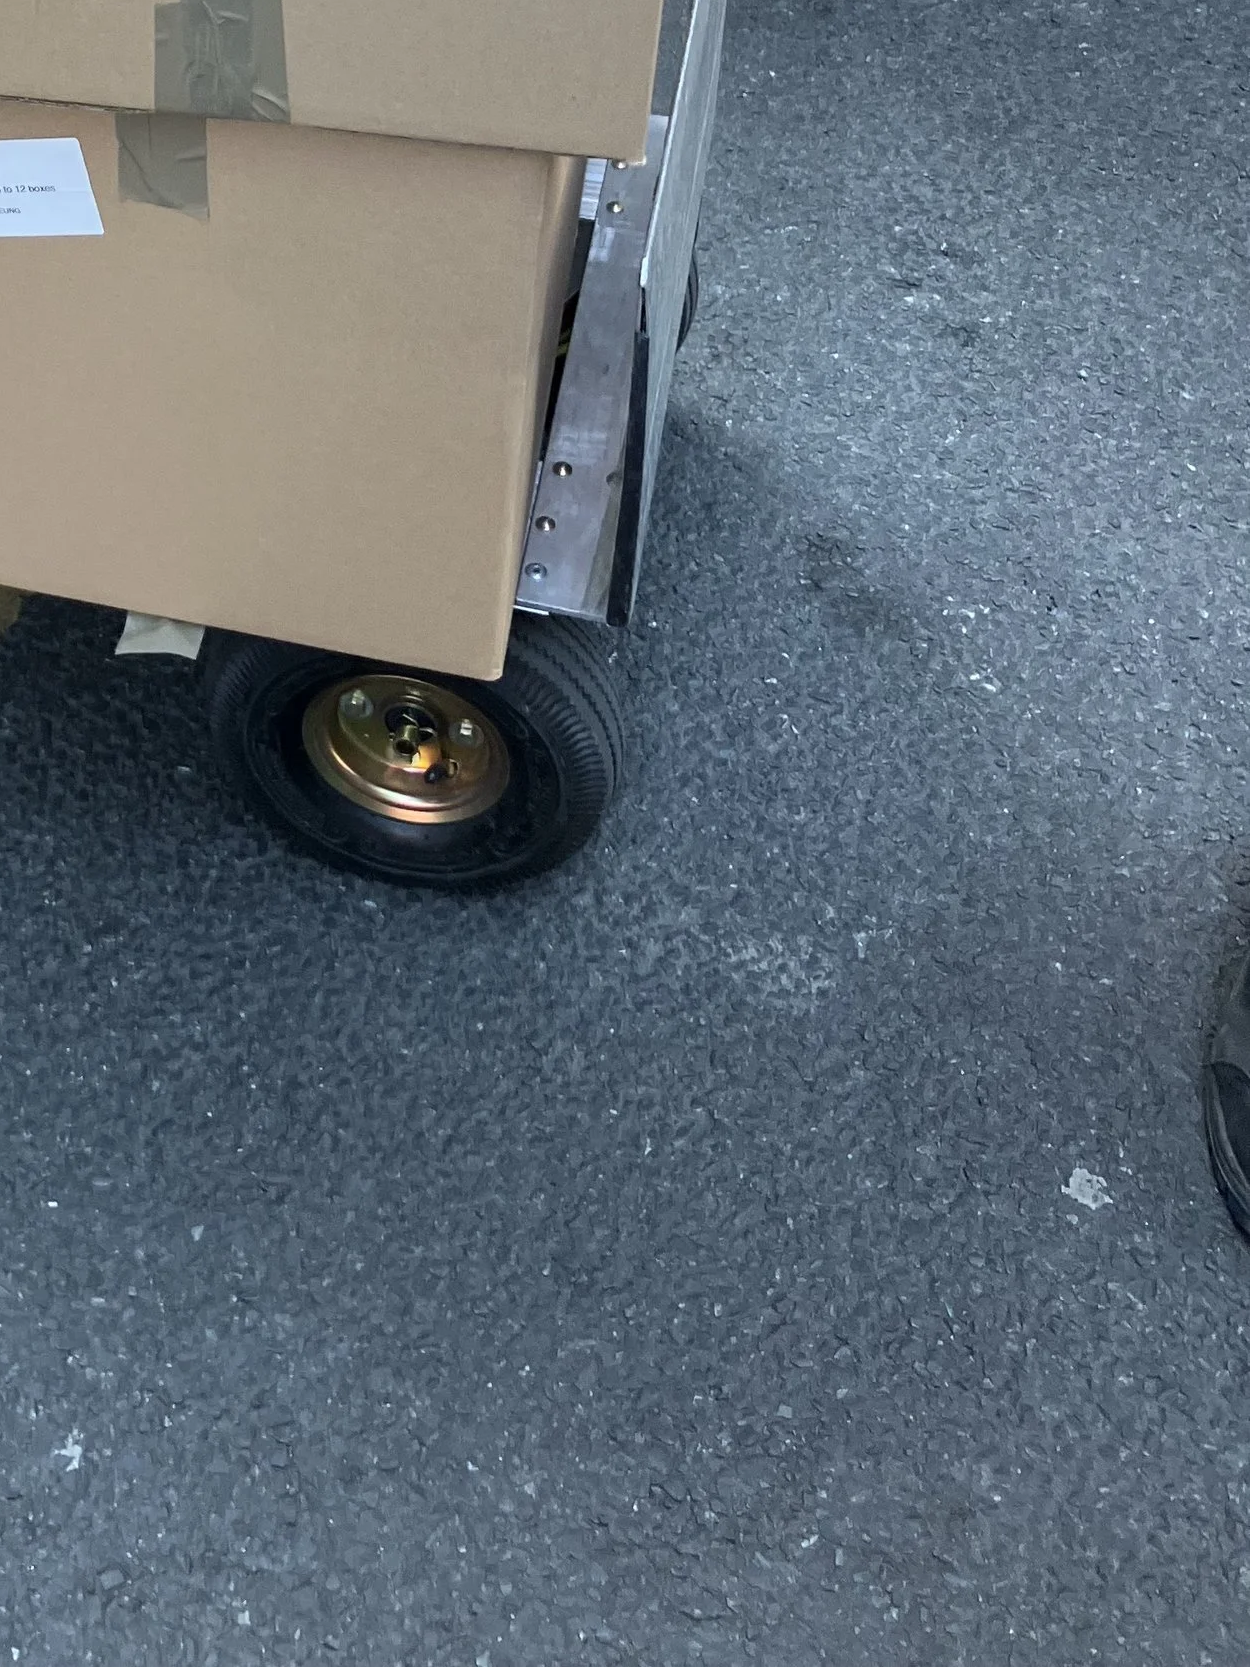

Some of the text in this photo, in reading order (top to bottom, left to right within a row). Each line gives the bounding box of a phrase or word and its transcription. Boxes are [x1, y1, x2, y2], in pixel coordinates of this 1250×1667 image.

[3, 185, 12, 193] to
[15, 185, 26, 193] 12
[29, 184, 56, 193] boxes
